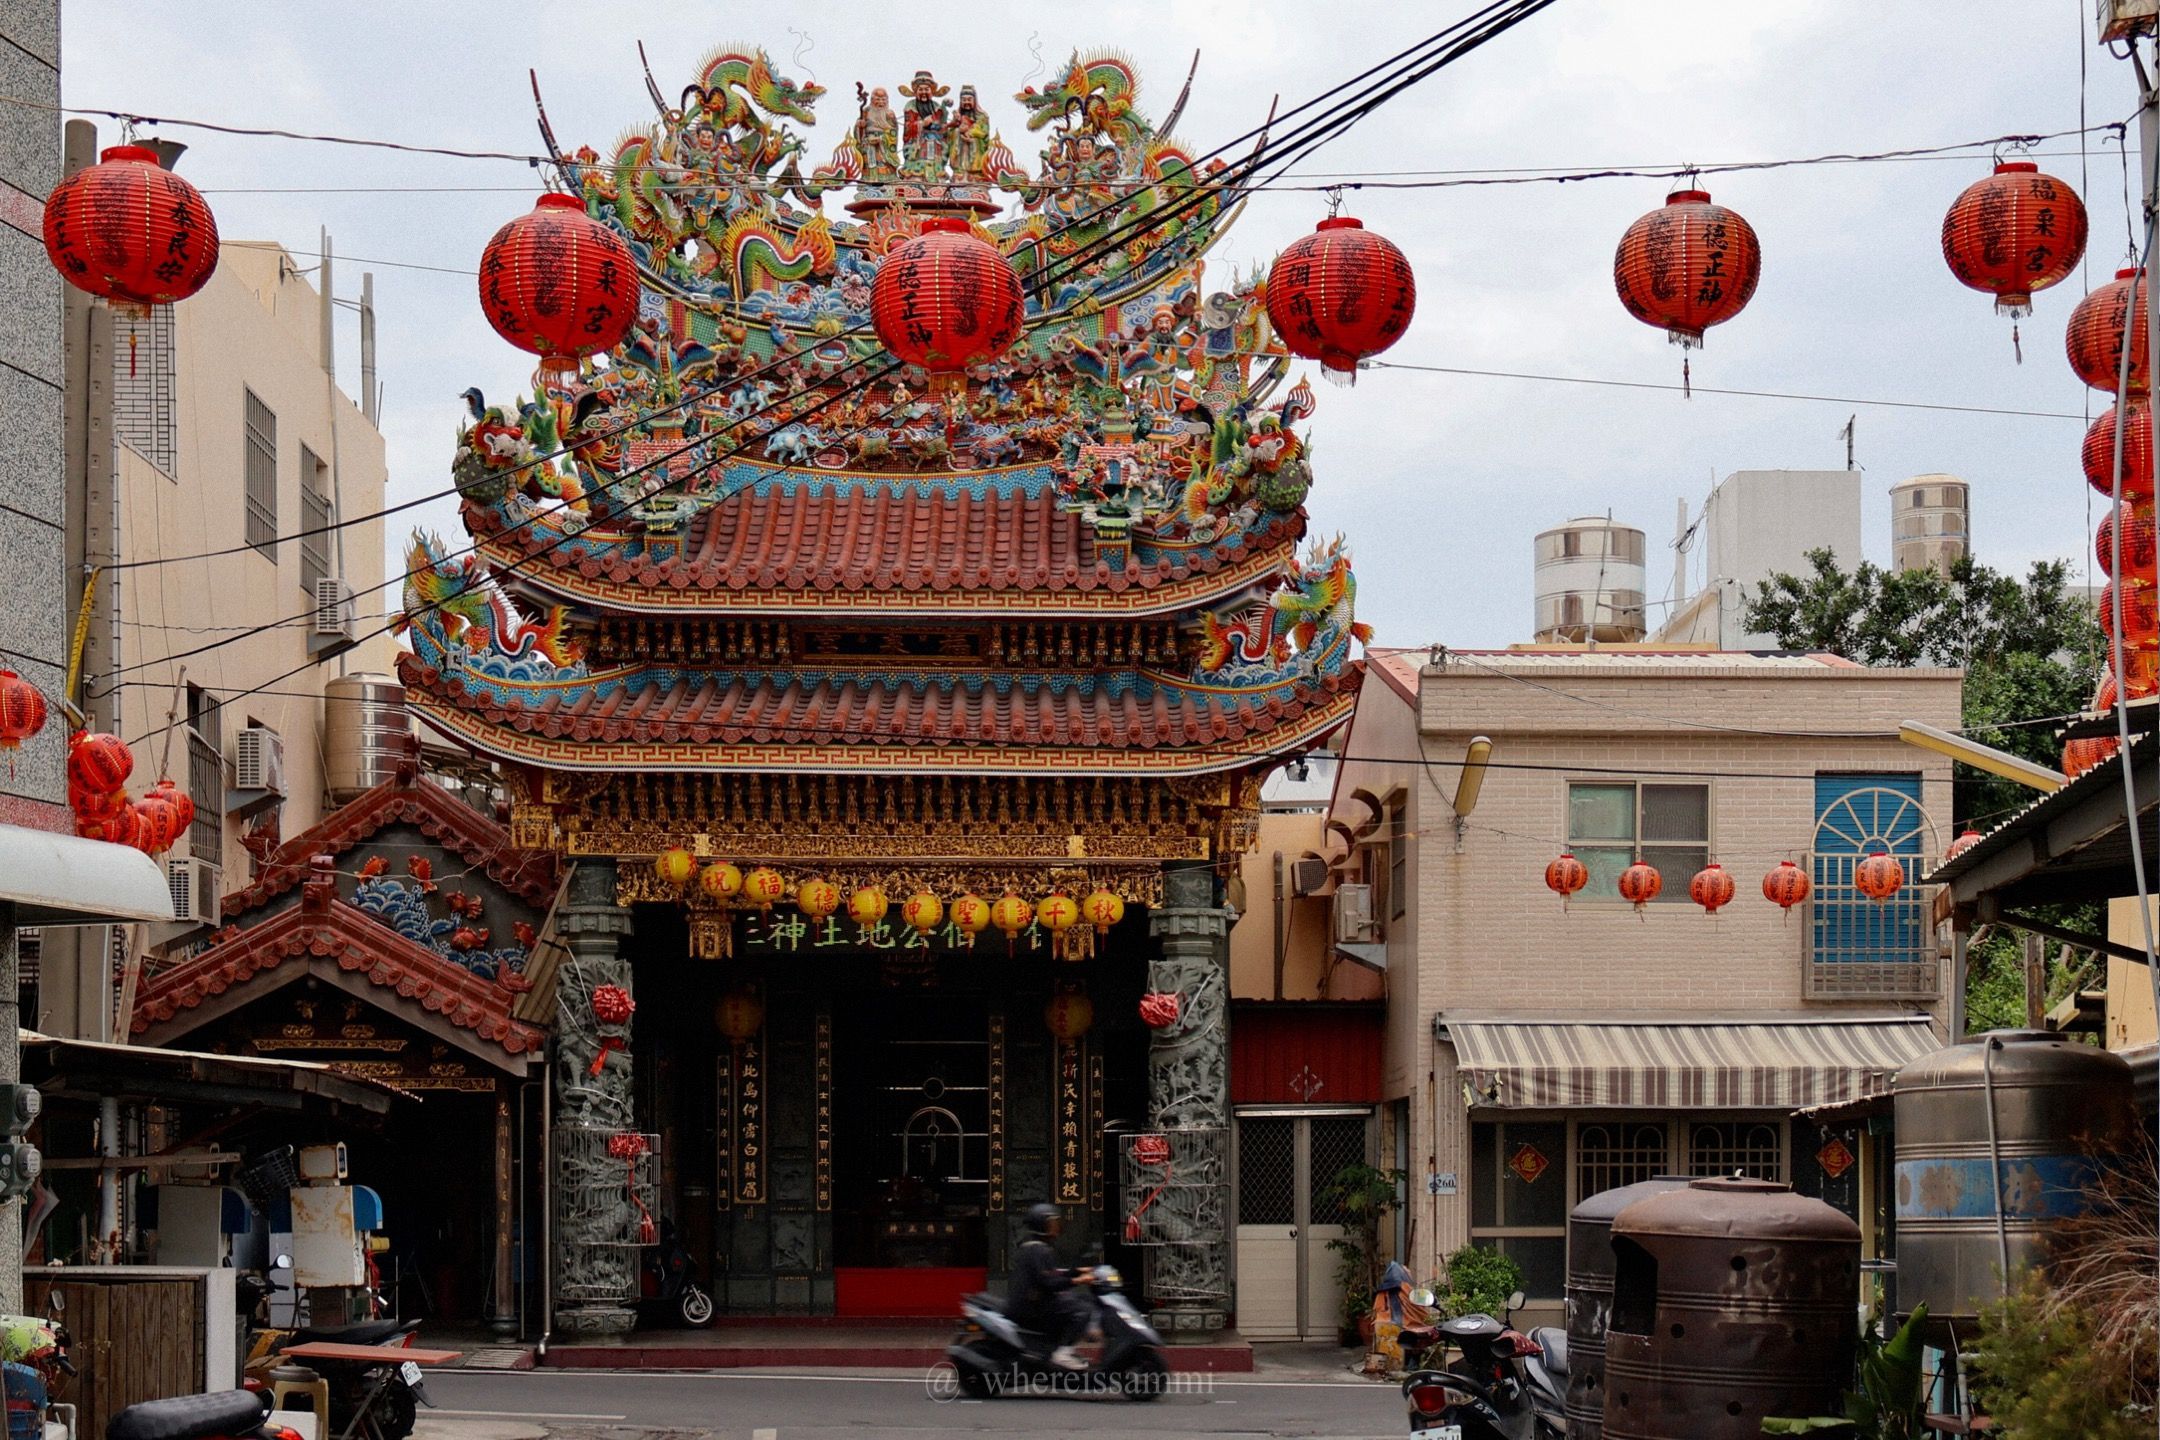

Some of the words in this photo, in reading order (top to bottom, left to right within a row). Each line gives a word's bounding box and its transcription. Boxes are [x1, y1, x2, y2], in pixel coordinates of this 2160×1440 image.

[897, 241, 933, 349] 福德正神
[1287, 238, 1324, 340] 風調雨順
[1694, 210, 1729, 309] 福德正神
[704, 869, 732, 893] 祝
[758, 872, 782, 896] 福
[815, 887, 836, 912] 德
[957, 899, 977, 926] 聖
[1045, 902, 1066, 925] 千
[1092, 898, 1116, 922] 秋
